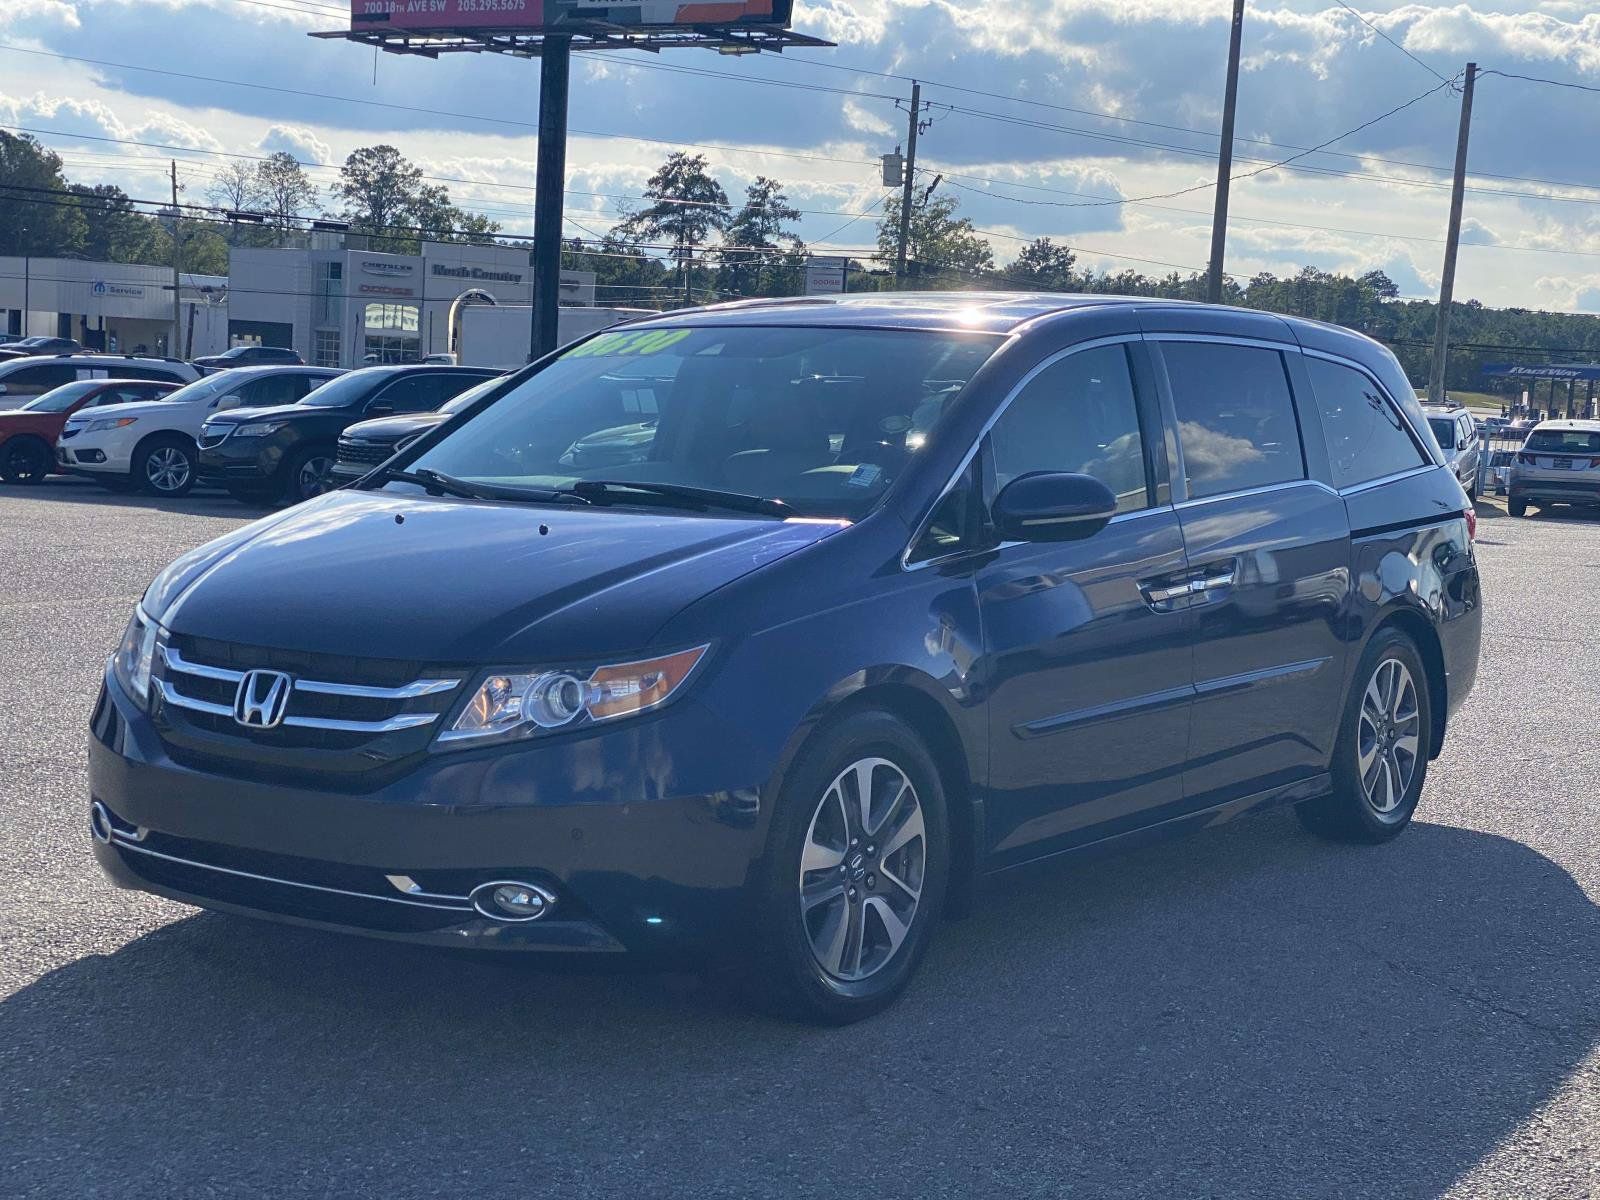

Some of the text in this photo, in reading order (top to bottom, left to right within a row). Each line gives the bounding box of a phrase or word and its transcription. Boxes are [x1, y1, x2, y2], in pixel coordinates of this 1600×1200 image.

[364, 2, 382, 13] 700
[407, 1, 427, 12] AVE
[430, 0, 447, 12] SW
[111, 287, 142, 295] Service
